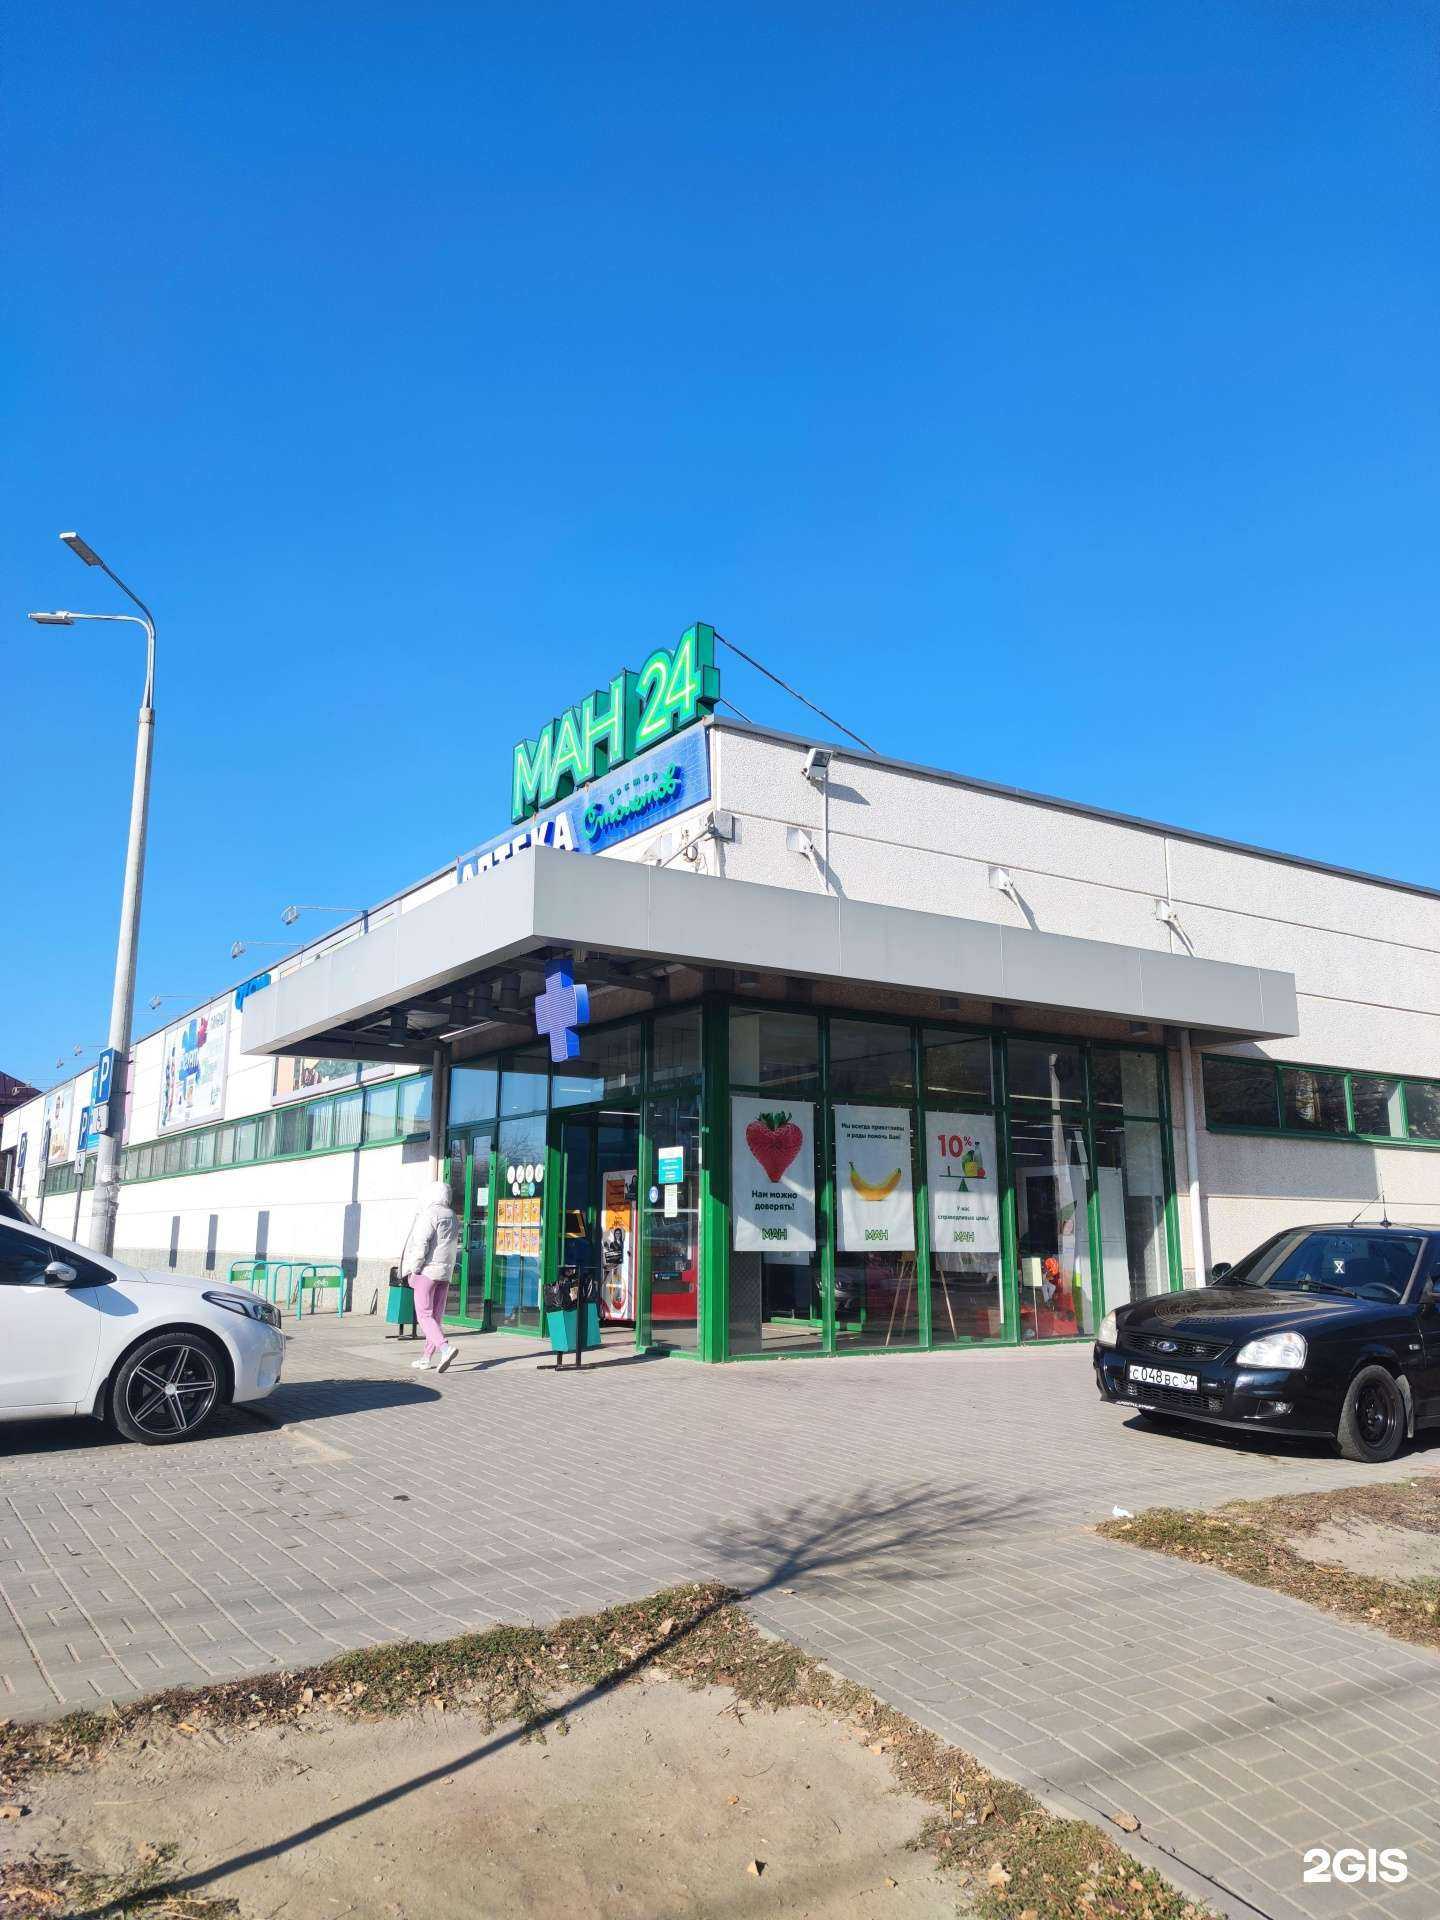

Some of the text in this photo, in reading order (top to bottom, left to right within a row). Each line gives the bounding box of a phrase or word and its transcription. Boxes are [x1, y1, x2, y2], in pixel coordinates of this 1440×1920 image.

[512, 622, 712, 824] МАН 24
[99, 1055, 110, 1098] P
[938, 1134, 973, 1157] 10%
[752, 1190, 768, 1198] Нам
[754, 1203, 795, 1211] доверять!
[762, 1228, 787, 1240] МАН
[864, 1229, 888, 1241] МАН
[953, 1231, 975, 1242] МАН
